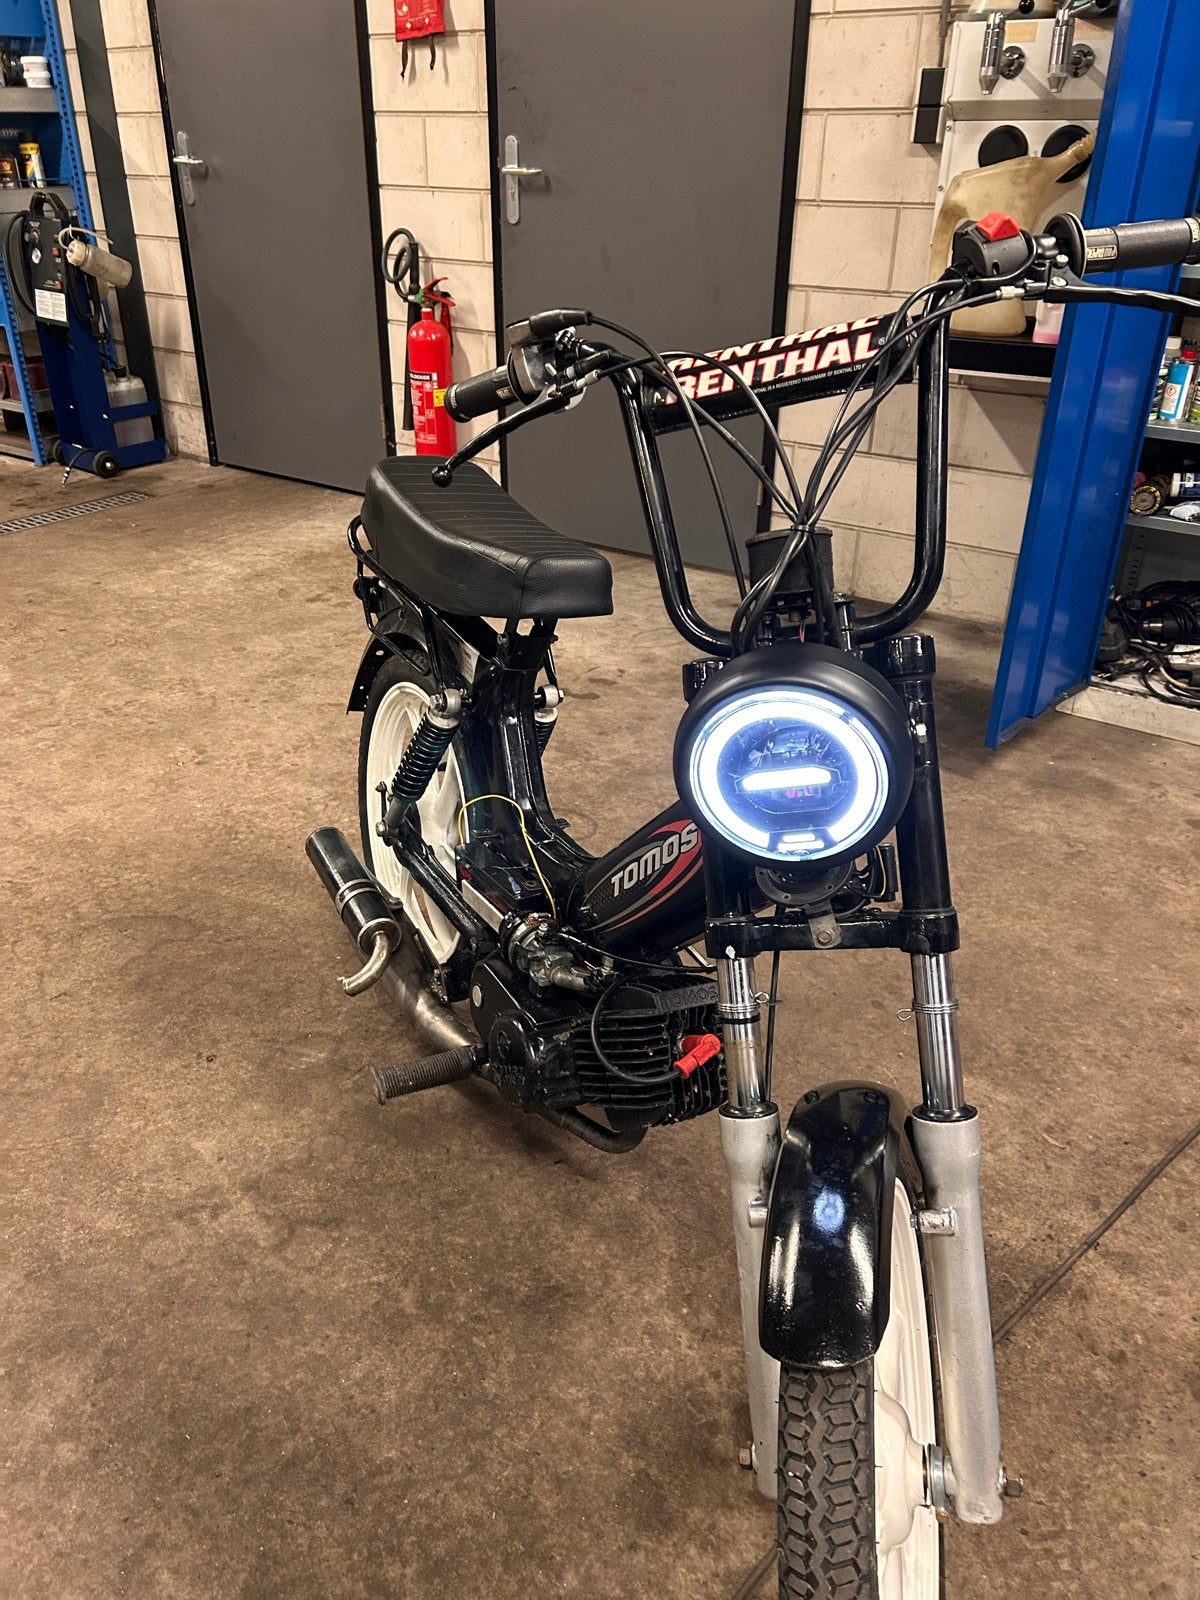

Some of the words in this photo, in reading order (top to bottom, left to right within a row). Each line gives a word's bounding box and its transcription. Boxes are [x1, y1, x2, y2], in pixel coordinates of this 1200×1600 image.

[776, 378, 801, 388] REGISTERED
[802, 372, 826, 382] TRADEMARK
[611, 822, 699, 898] TOMOS
[661, 985, 718, 1010] TOMOS
